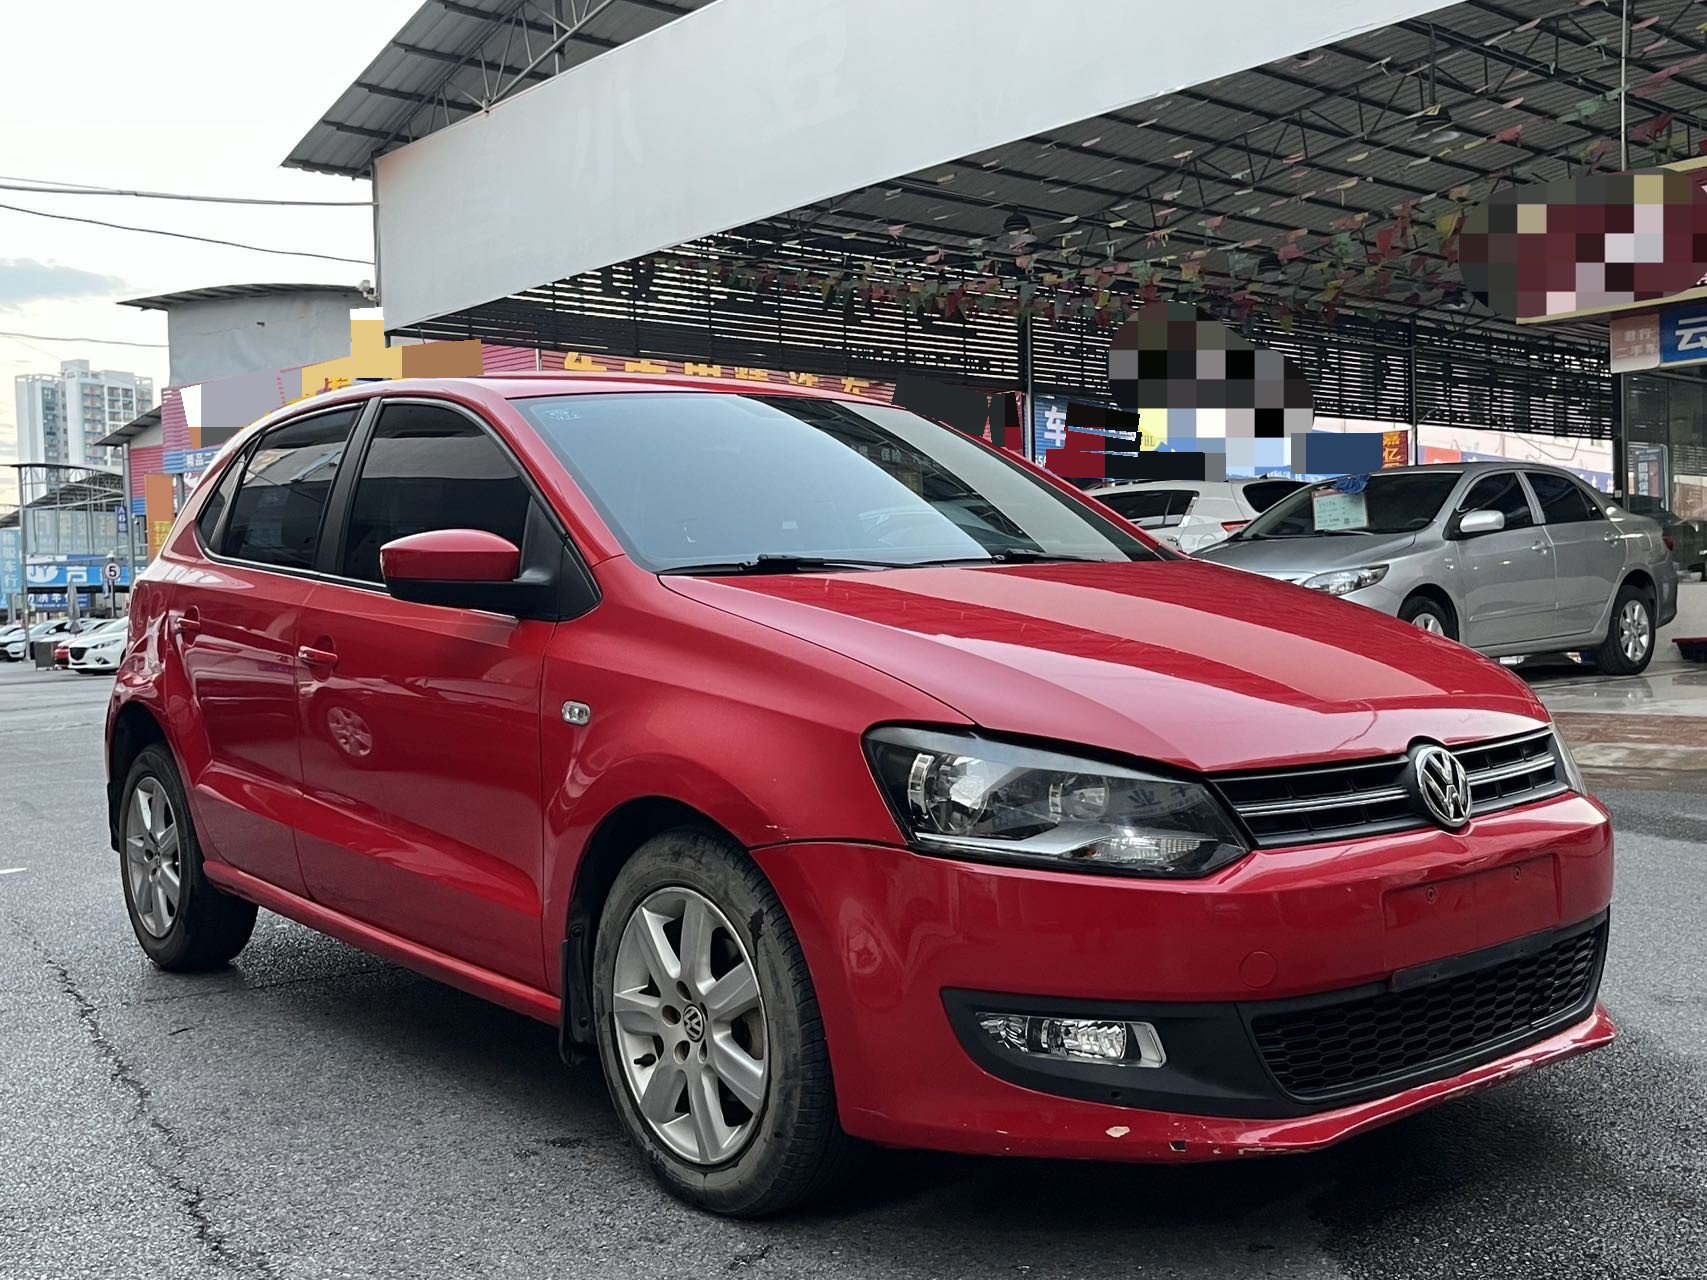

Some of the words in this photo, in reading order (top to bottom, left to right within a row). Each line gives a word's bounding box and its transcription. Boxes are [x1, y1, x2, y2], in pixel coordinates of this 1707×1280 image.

[186, 450, 219, 467] 精品二
[109, 566, 117, 577] 5
